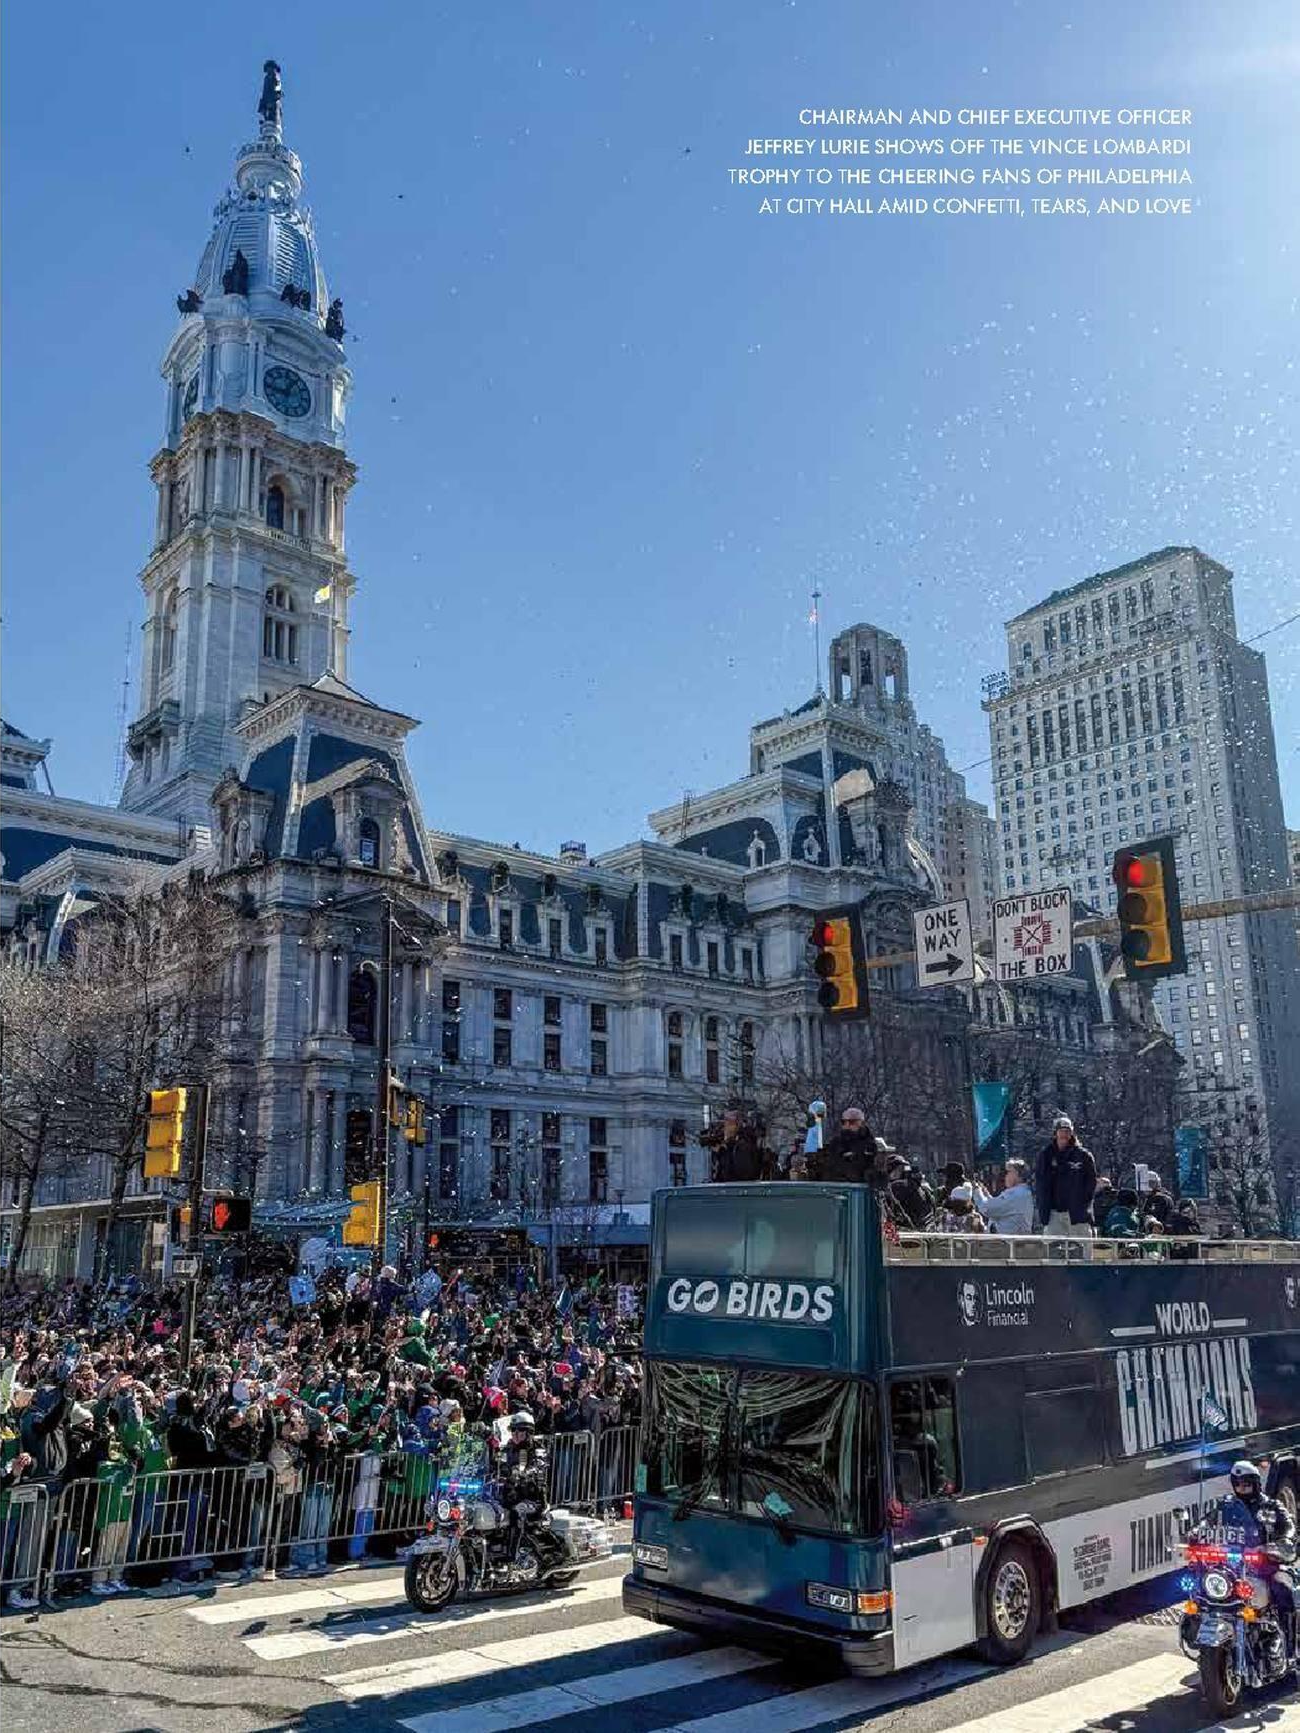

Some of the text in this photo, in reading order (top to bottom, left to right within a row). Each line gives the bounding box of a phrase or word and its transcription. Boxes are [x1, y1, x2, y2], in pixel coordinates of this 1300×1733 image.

[1030, 891, 1068, 912] BLOCK
[923, 908, 959, 932] ONE
[923, 928, 962, 953] WAY
[1000, 953, 1068, 979] THE BOX
[667, 1277, 836, 1322] GO BIRDS
[984, 1281, 1035, 1305] Lincoln
[987, 1310, 1028, 1326] Financial
[1155, 1301, 1211, 1336] WORLD
[1116, 1337, 1258, 1456] CHAMPIONS
[1130, 1510, 1173, 1574] THANK
